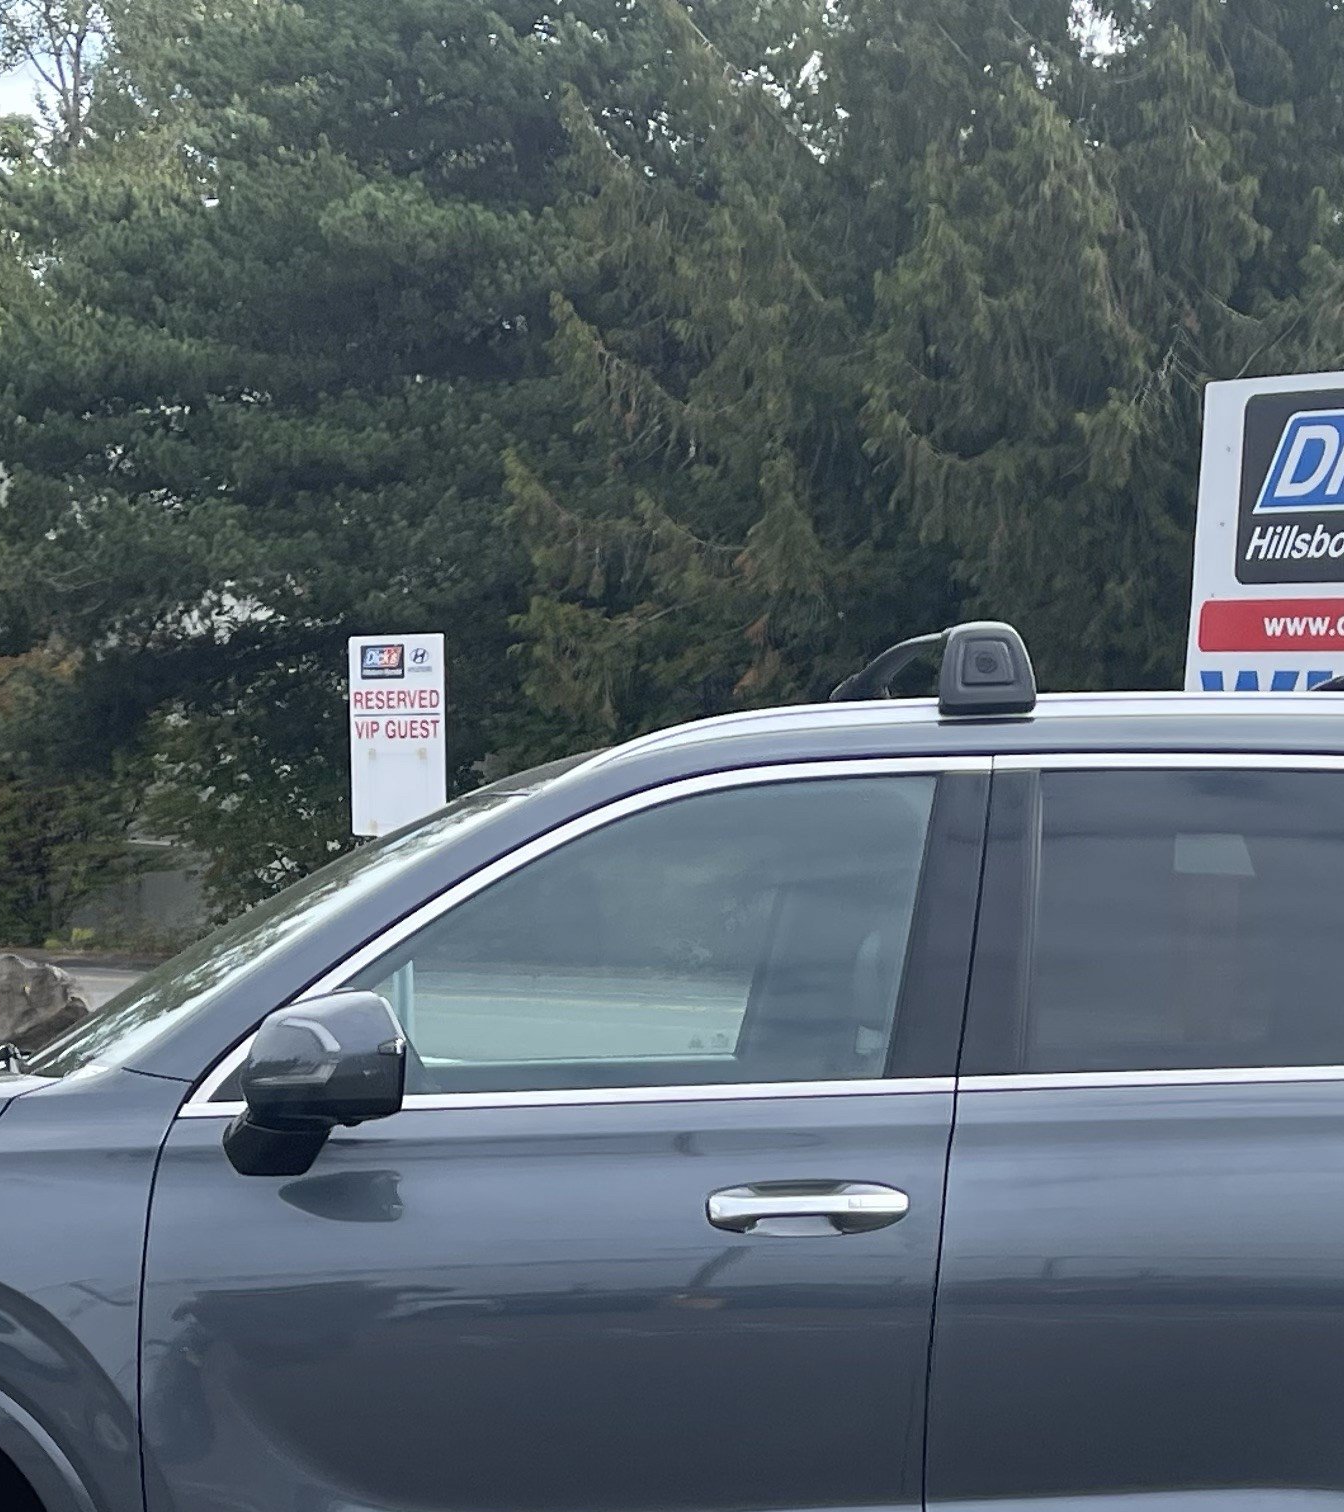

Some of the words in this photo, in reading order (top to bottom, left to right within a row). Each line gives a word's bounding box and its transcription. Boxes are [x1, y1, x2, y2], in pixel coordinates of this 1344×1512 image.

[353, 689, 440, 710] RESERVED
[354, 720, 380, 739] VIP
[385, 719, 441, 740] GUEST
